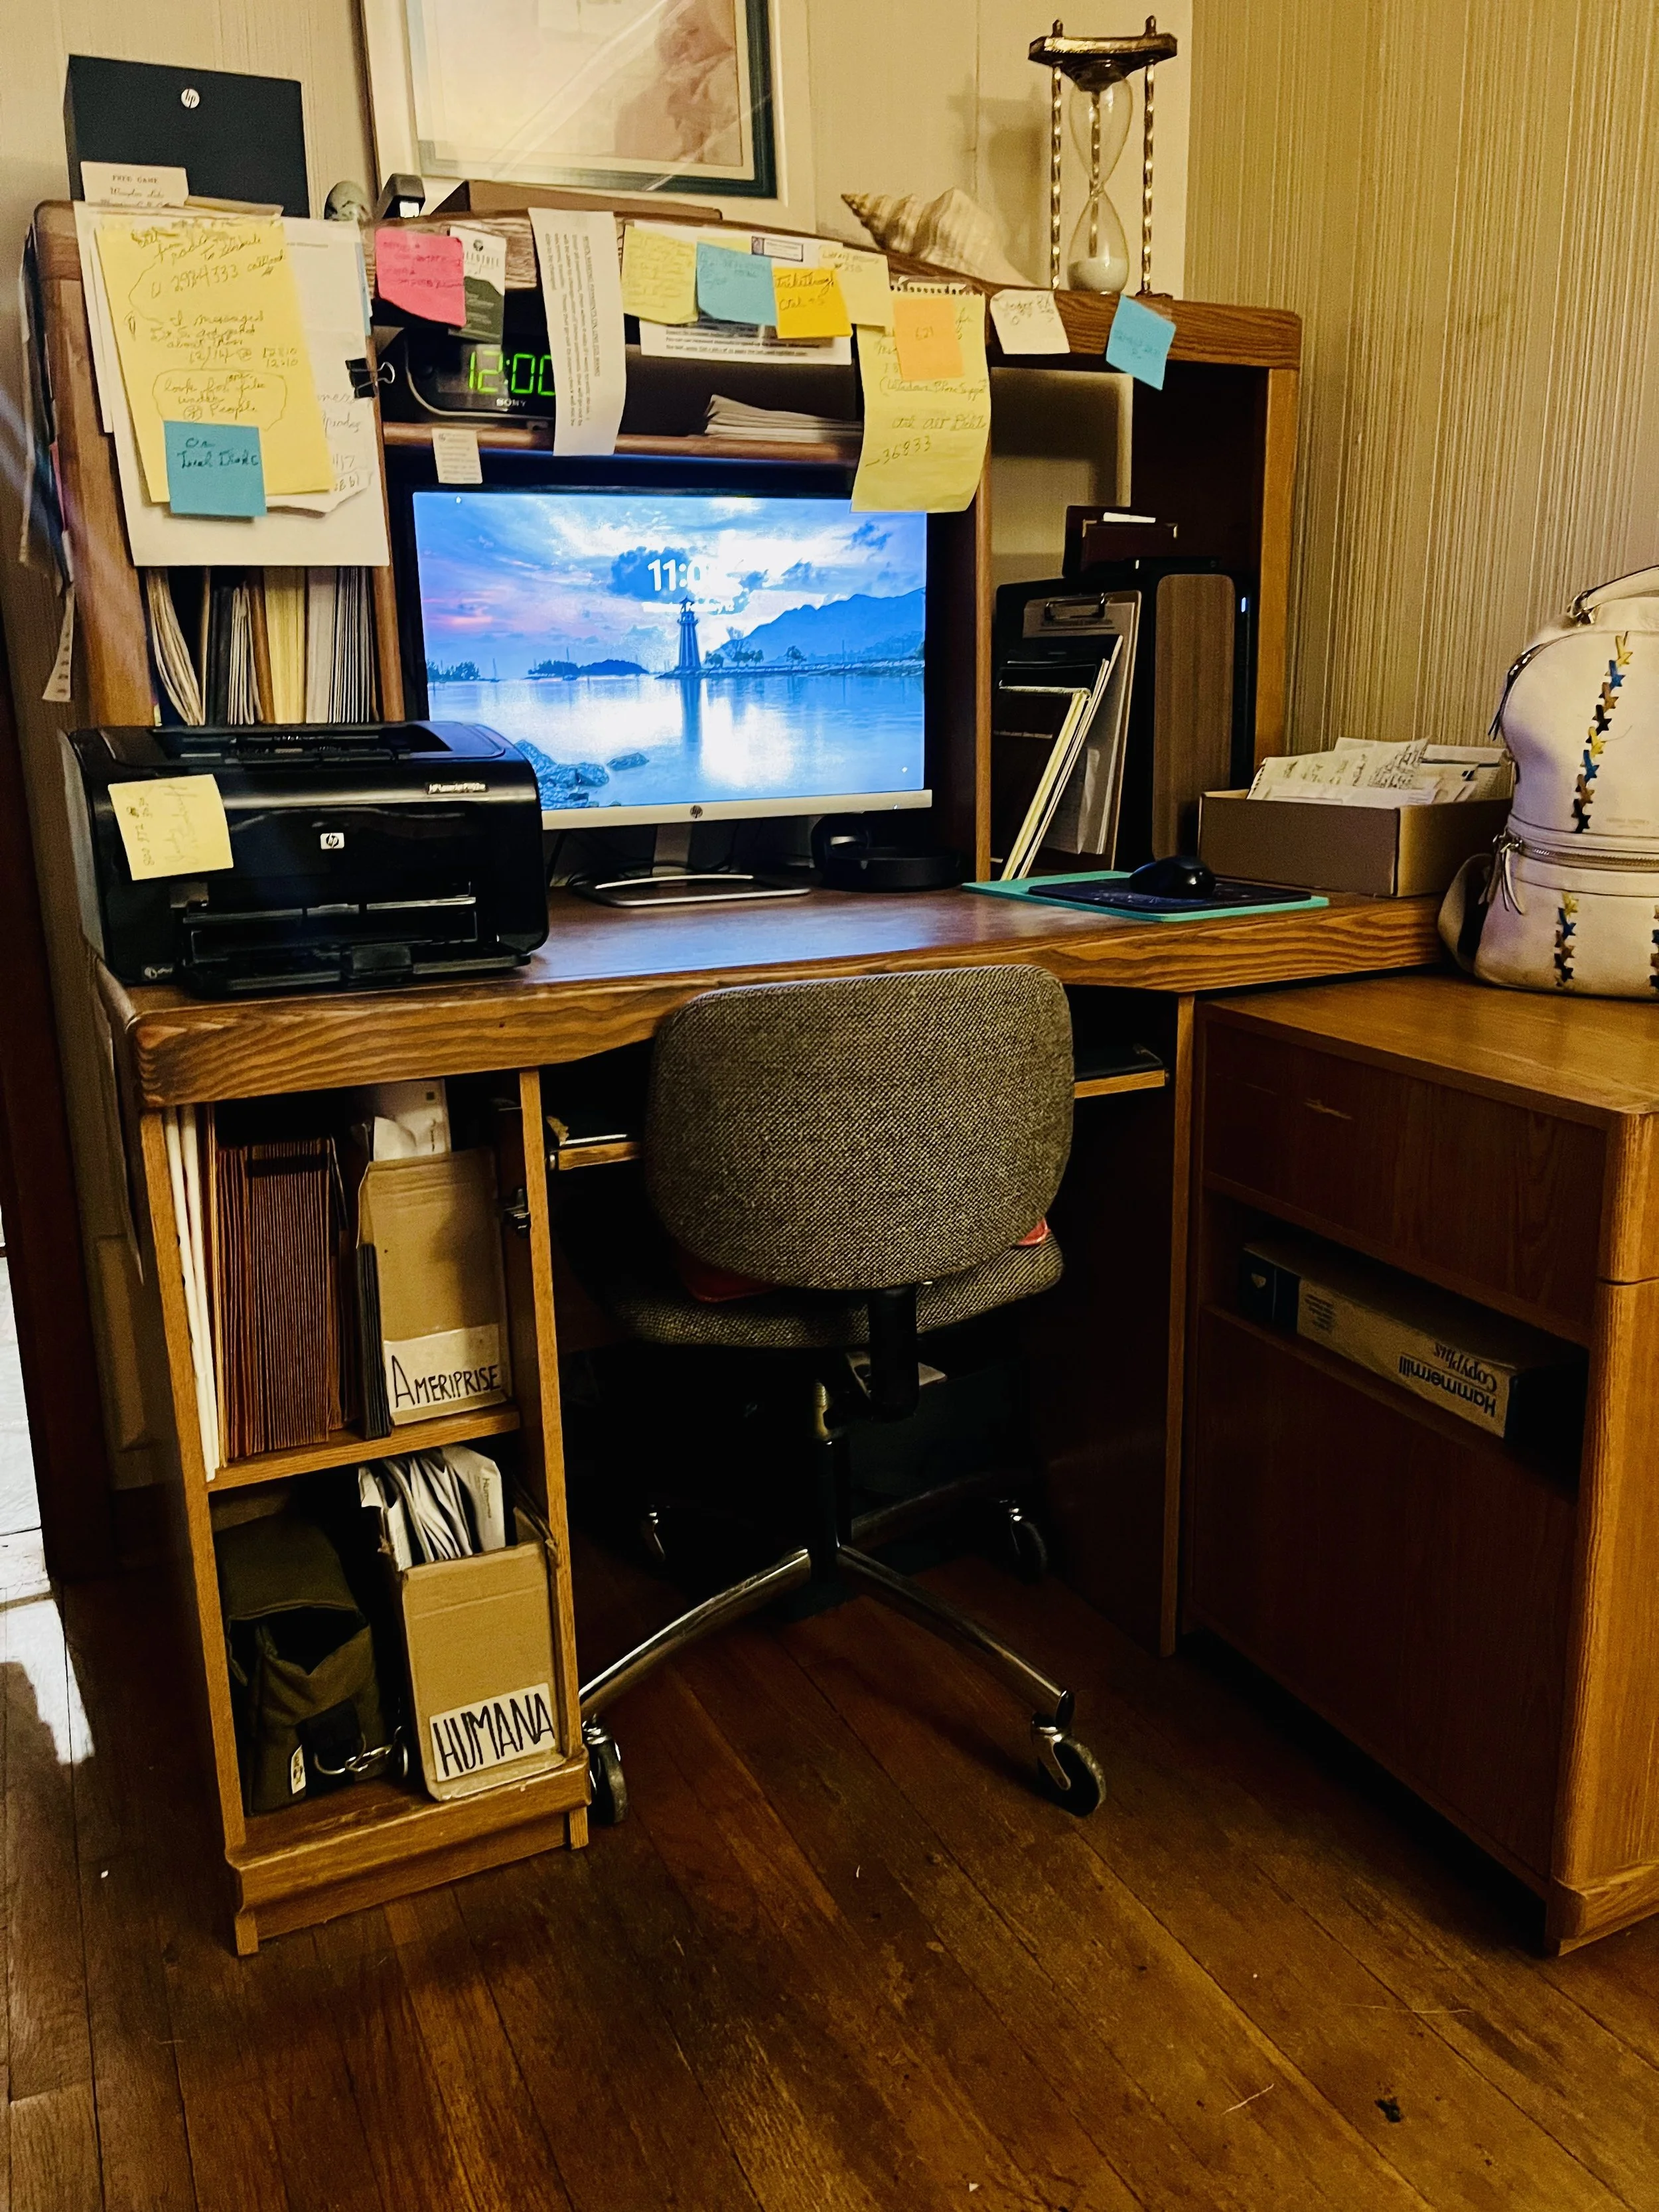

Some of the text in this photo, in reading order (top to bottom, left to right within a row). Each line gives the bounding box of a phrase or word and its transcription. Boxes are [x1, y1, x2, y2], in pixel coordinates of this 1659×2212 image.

[183, 88, 198, 108] hp
[392, 1354, 502, 1408] AMERIPRISE
[1398, 1355, 1496, 1418] Hammermill
[432, 1692, 556, 1777] HUMANA
